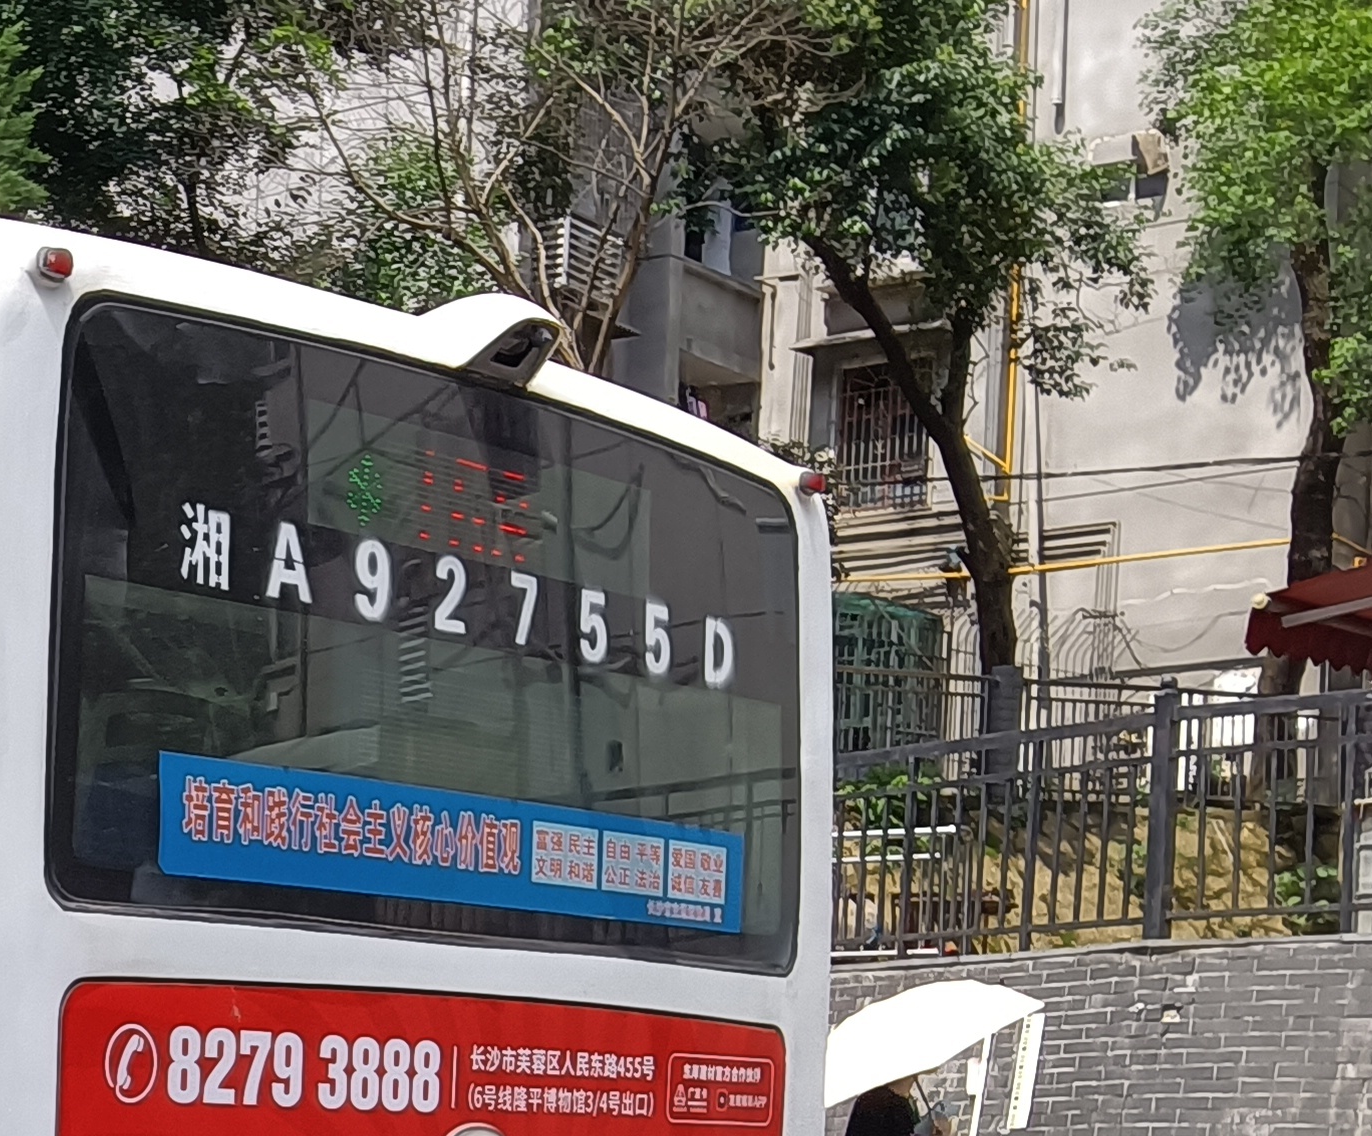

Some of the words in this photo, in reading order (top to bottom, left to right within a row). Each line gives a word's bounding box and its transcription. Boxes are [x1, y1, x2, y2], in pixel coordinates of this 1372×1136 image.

[182, 776, 522, 875] 培育和践行社会主义核心价值观
[536, 829, 563, 852] 富强
[568, 833, 596, 857] 民主
[606, 838, 631, 862] 自由
[636, 842, 662, 866] 平等
[535, 856, 563, 879] 文明
[567, 859, 595, 883] 和谐
[671, 847, 697, 871] 爱国
[700, 851, 724, 874] 敬业
[604, 866, 630, 887] 公正
[635, 869, 661, 891] 法治
[670, 872, 695, 895] 诚信
[698, 877, 723, 899] 友善
[167, 1025, 304, 1108] 8279
[317, 1035, 441, 1114] 3888
[469, 1043, 655, 1081] 长沙市芙蓉区人民东路455号
[467, 1083, 654, 1118] (6号线隆平博物馆3/4号出口)
